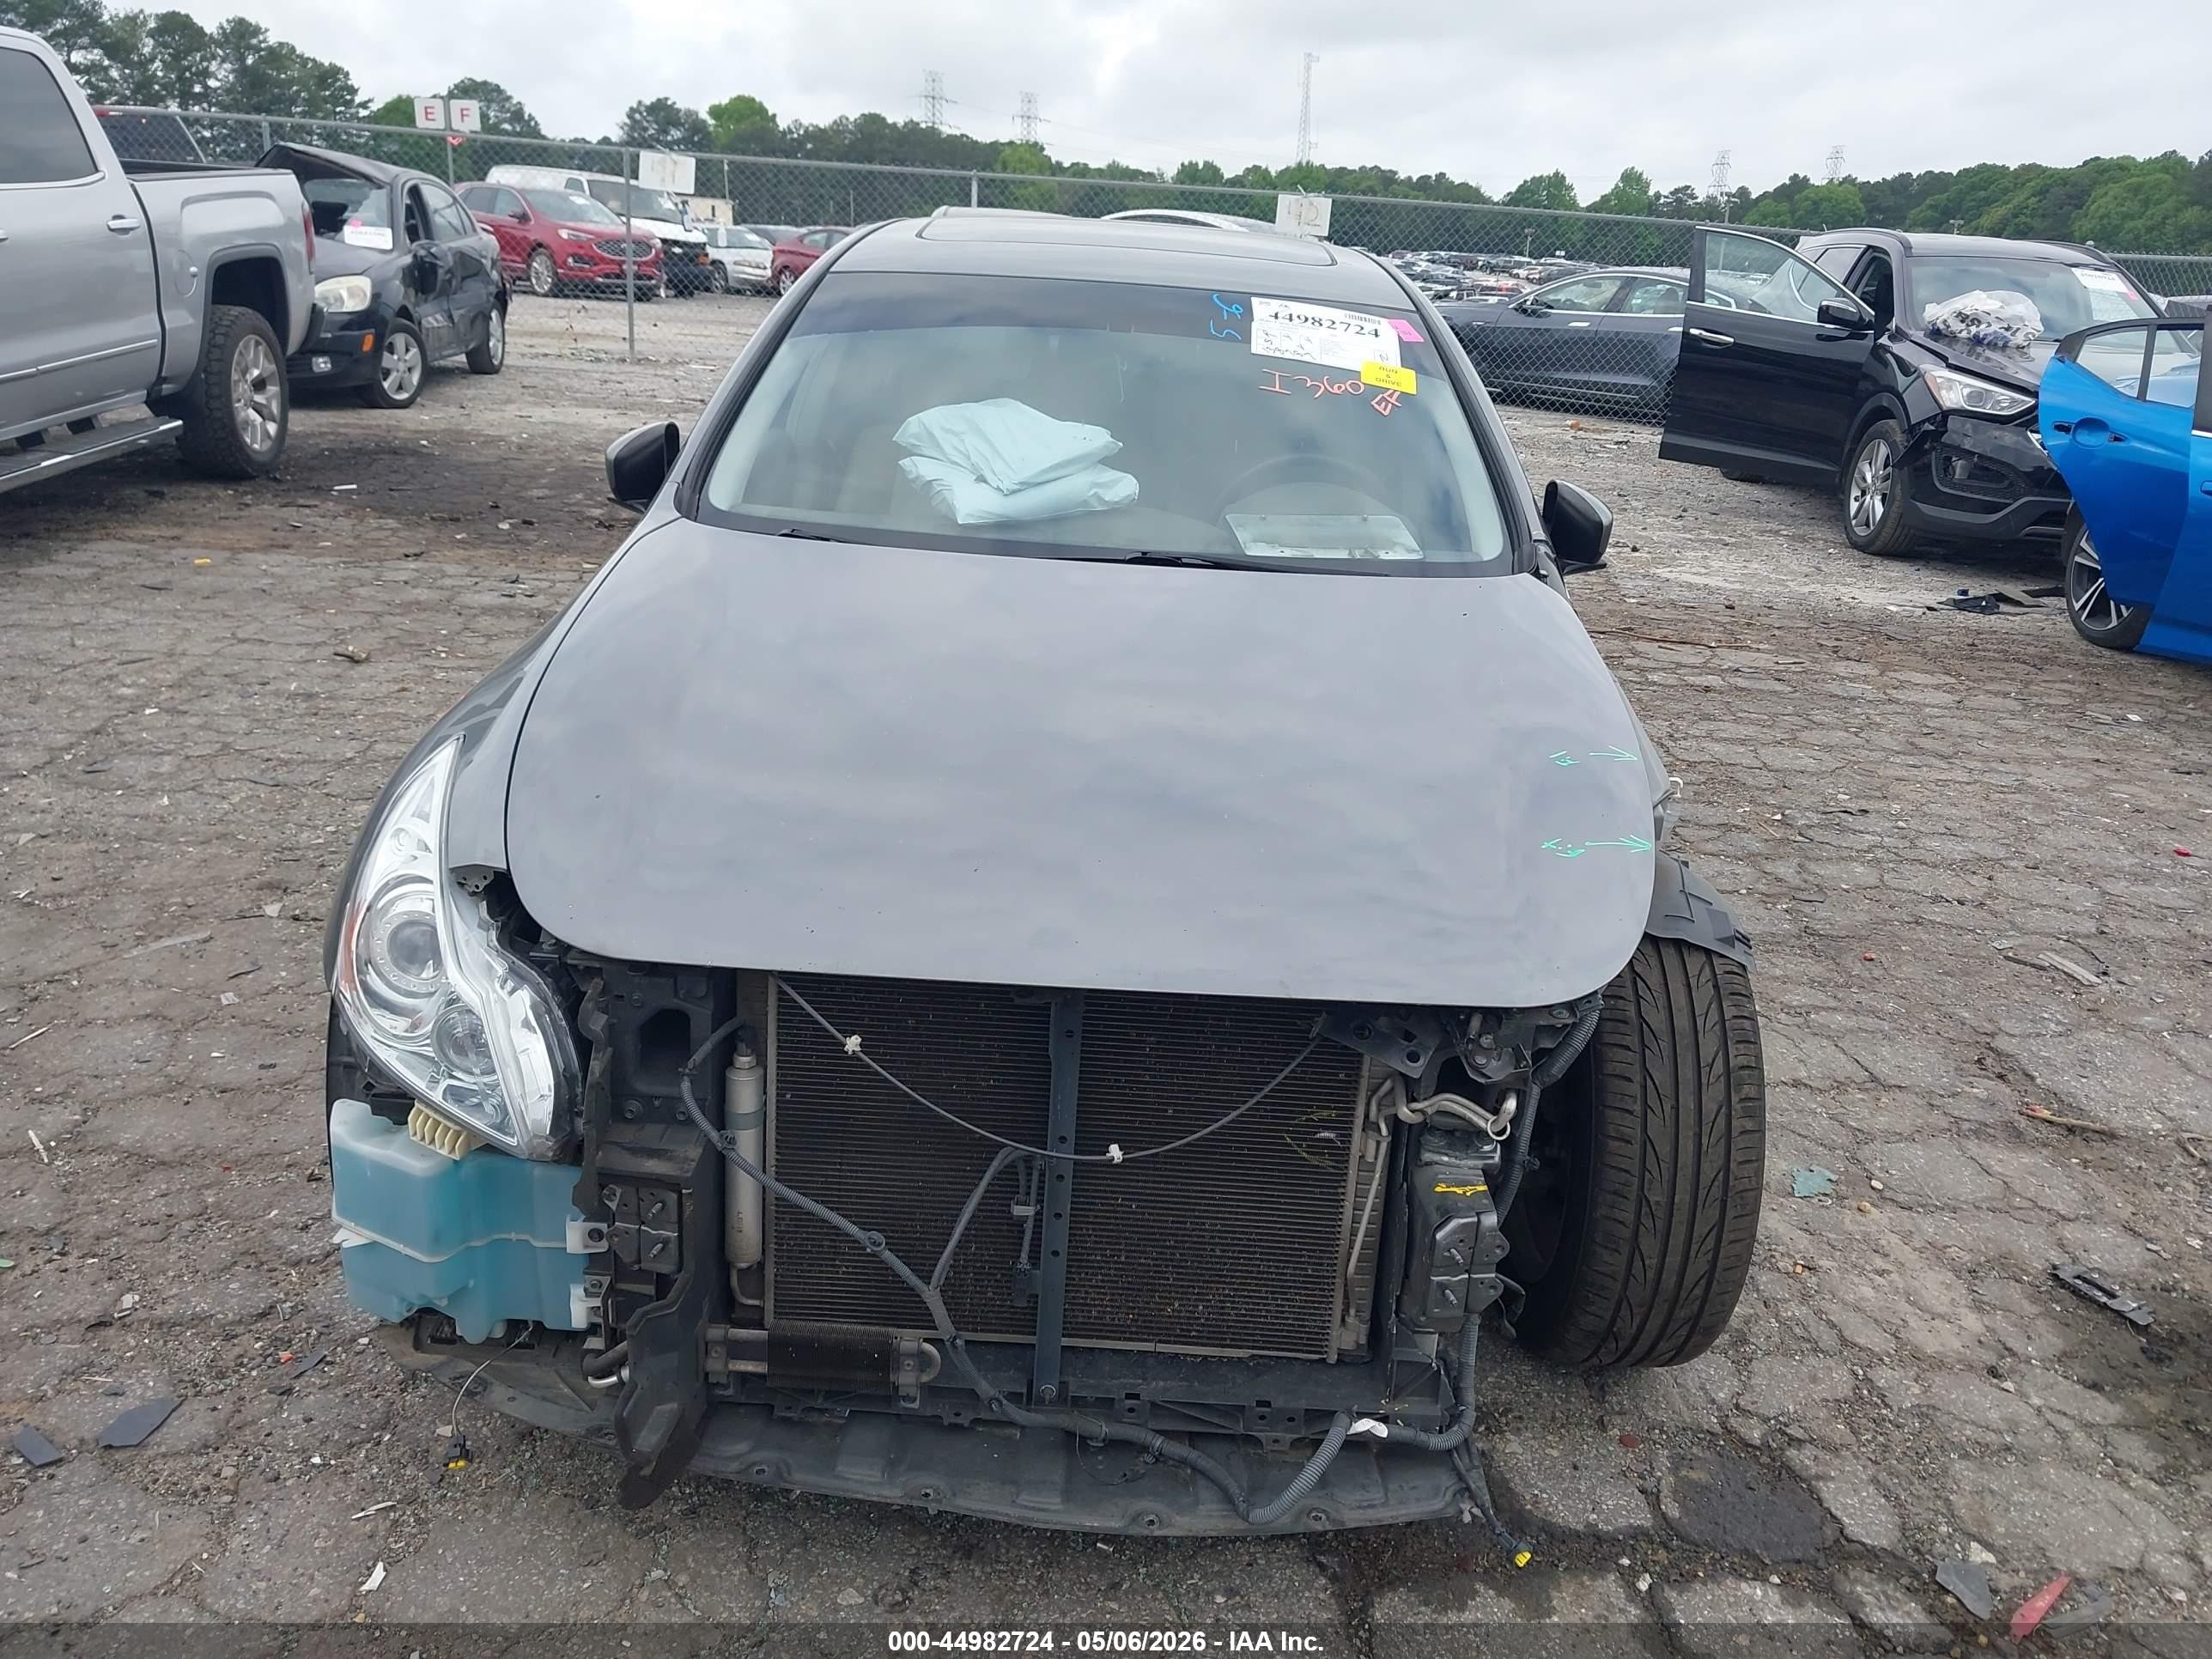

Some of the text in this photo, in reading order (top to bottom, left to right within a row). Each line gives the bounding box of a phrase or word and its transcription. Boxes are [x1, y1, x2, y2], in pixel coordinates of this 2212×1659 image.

[424, 106, 436, 121] E
[460, 107, 470, 123] F
[1268, 311, 1381, 338] 44982724
[1379, 366, 1399, 374] RUN
[1375, 377, 1402, 387] DRIVE
